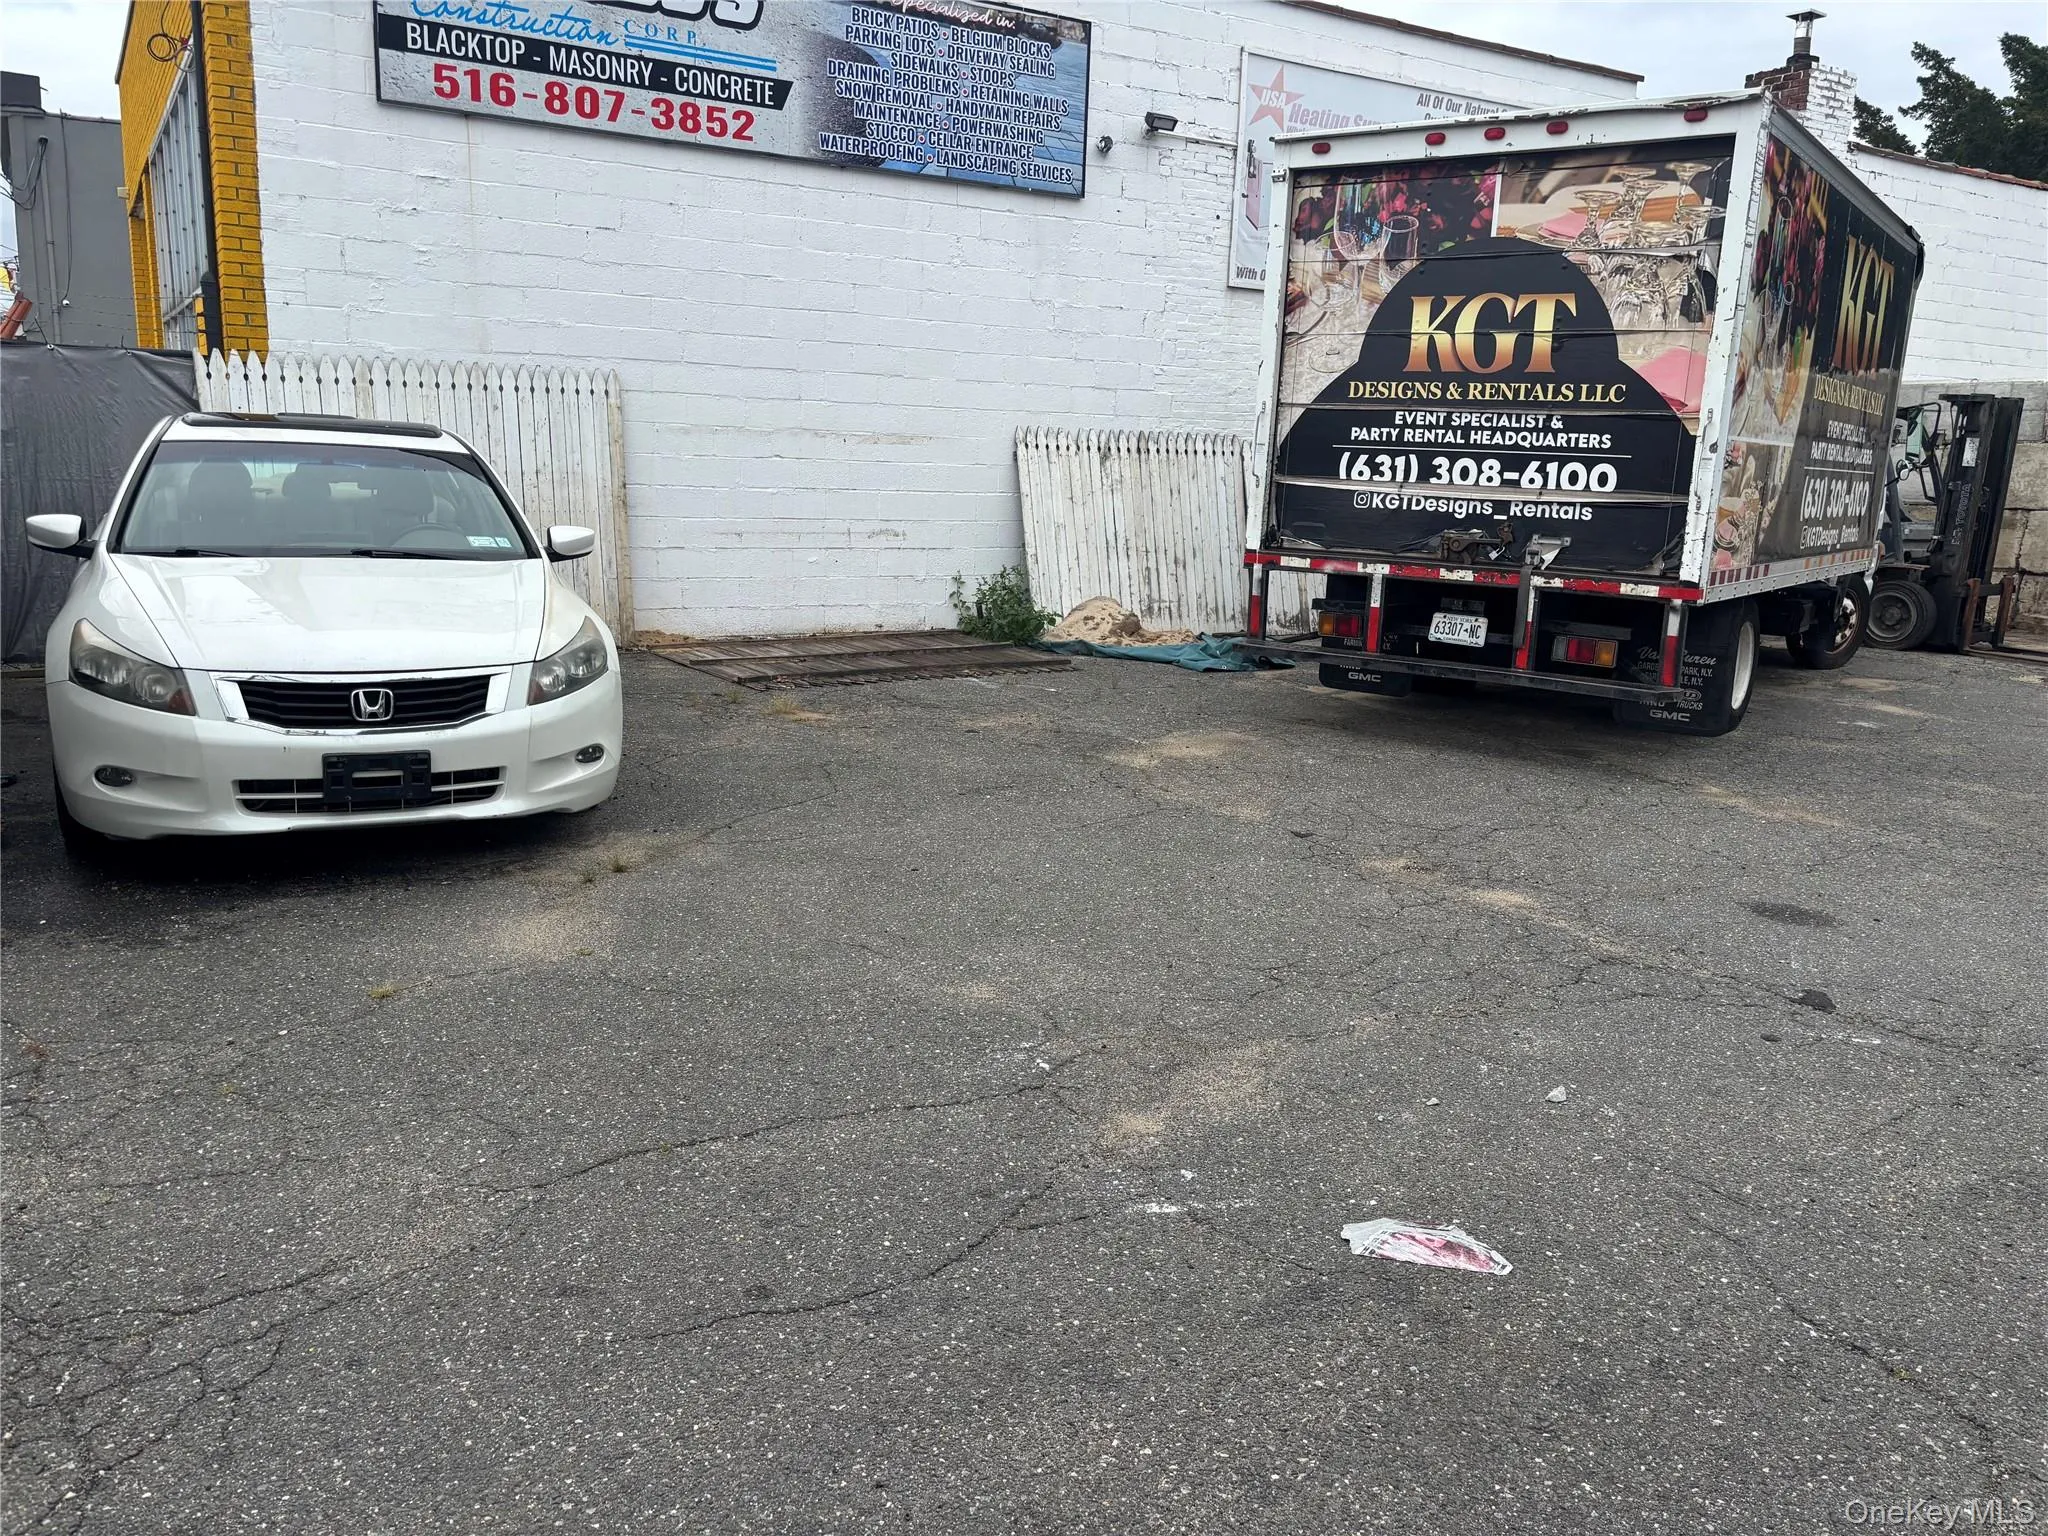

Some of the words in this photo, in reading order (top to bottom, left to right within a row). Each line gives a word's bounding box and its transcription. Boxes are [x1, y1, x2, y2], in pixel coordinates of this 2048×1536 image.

[851, 6, 893, 30] BRICK
[896, 15, 940, 38] PATIOS
[951, 26, 1003, 51] BELGIUM
[1006, 36, 1051, 59] BLOCKS
[996, 13, 1016, 30] in:
[406, 22, 526, 66] BLACKTOP
[549, 46, 653, 86] MASONRY
[675, 67, 775, 105] CONCRETE
[845, 24, 901, 50] PARKING
[905, 36, 936, 56] LOTS
[947, 44, 1007, 69] DRIVEWAY
[1009, 55, 1056, 78] SEALING
[828, 59, 890, 86] DRAINING
[893, 70, 960, 96] PROBLEMS
[970, 84, 1030, 109] RETAINING
[1033, 94, 1069, 115] WALLS
[890, 52, 959, 79] SIDEWALKS
[970, 66, 1015, 88] STOOPS
[433, 63, 756, 142] 516-807-3852
[836, 79, 873, 100] SNOW
[875, 84, 933, 111] REMOVAL
[945, 97, 1010, 122] HANDYMAN
[1013, 109, 1061, 131] REPAIRS
[1261, 88, 1287, 108] USA
[1288, 103, 1350, 128] Heating
[1417, 93, 1431, 107] All
[1433, 95, 1444, 110] Of
[1446, 98, 1462, 113] Our
[854, 100, 940, 130] MAINTENANCE
[951, 116, 1045, 146] POWERWASHING
[865, 120, 916, 144] STUCCO
[928, 130, 972, 152] CELLAR
[975, 137, 1034, 160] ENTRANCE
[819, 132, 925, 164] WATERPROOFING
[936, 149, 1017, 176] LANDSCAPING
[1020, 160, 1073, 183] SERVICES
[1236, 266, 1257, 280] With
[1831, 234, 1896, 376] KGT
[1402, 292, 1577, 374] KGT
[1348, 381, 1442, 400] DESIGNS
[1446, 382, 1463, 400] &
[1468, 383, 1574, 402] RENTALS
[1578, 384, 1627, 403] LLC
[1814, 374, 1845, 406] DESIGNS
[1350, 427, 1400, 442] PARTY
[1403, 428, 1466, 445] RENTAL
[1469, 431, 1612, 449] HEADQUARTERS
[1395, 411, 1446, 426] EVENT
[1451, 412, 1546, 429] SPECIALIST
[1550, 415, 1564, 429] &
[1338, 451, 1419, 483] (631)
[1429, 456, 1618, 493] 308-6100
[1372, 491, 1593, 521] KGTDesigns_Rentals
[1800, 475, 1828, 521] (631)
[1827, 479, 1870, 518] 308-6100
[1637, 647, 1660, 660] Va
[1348, 671, 1382, 683] GMC
[1650, 709, 1690, 721] GMC
